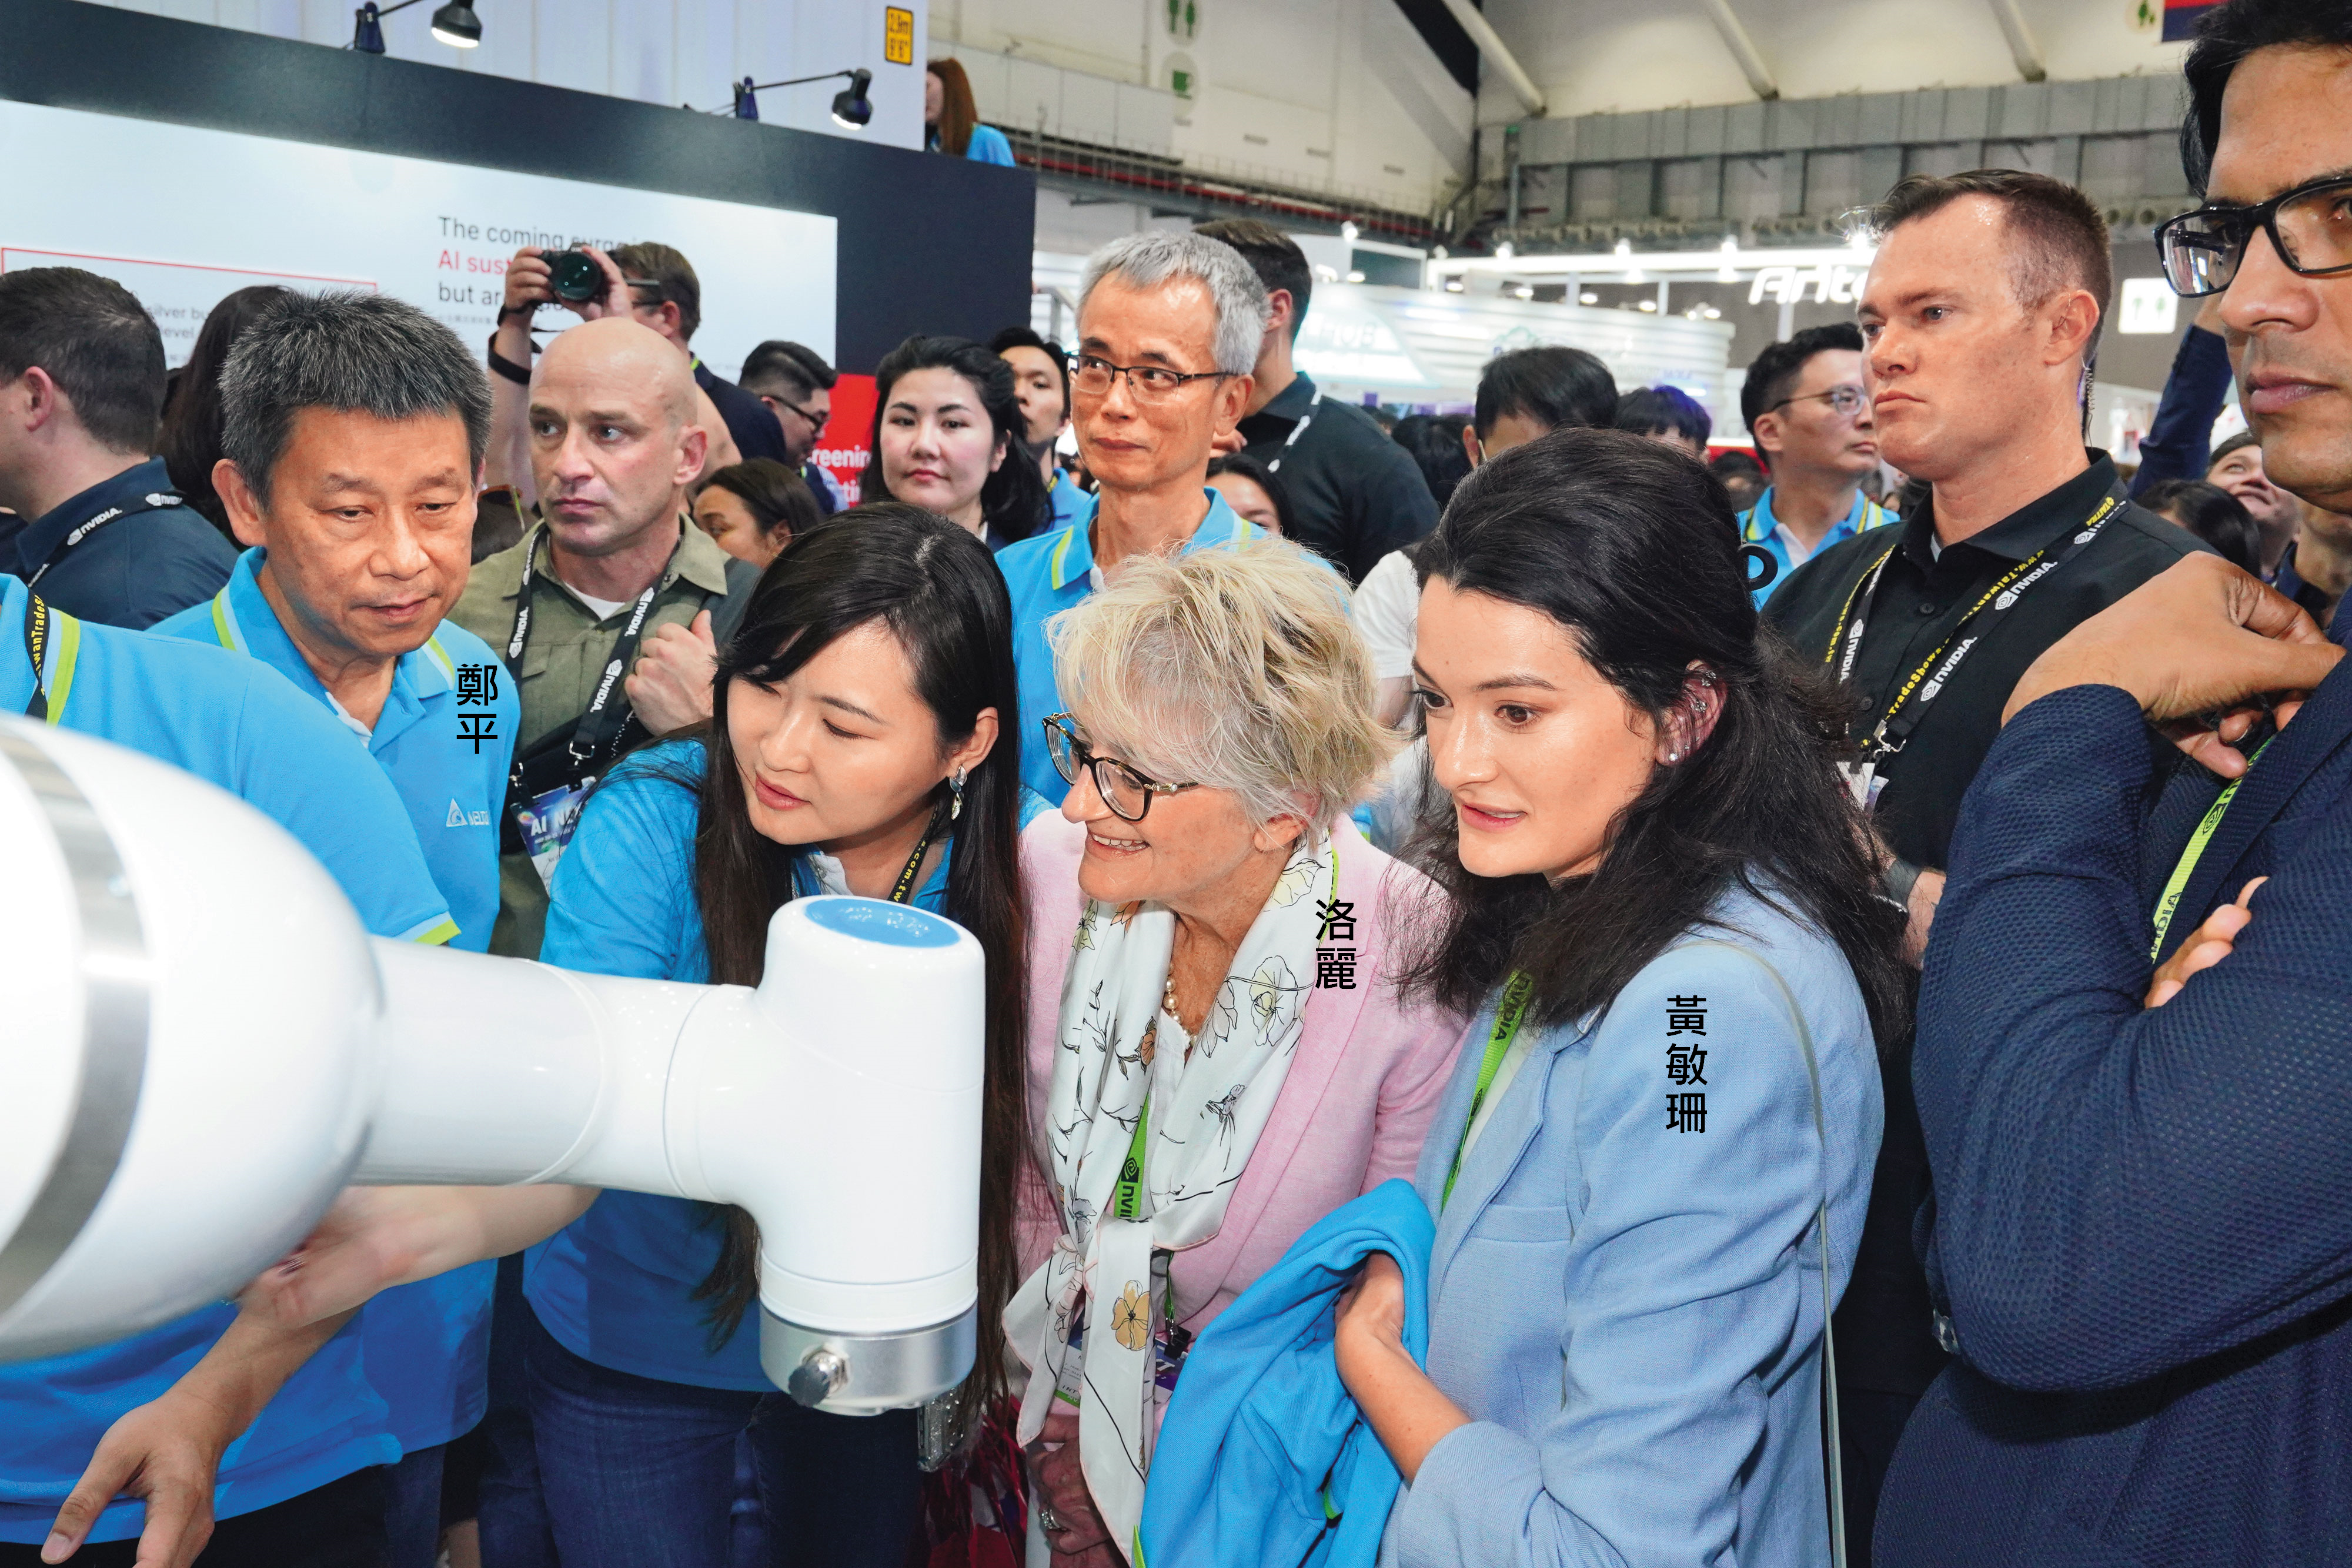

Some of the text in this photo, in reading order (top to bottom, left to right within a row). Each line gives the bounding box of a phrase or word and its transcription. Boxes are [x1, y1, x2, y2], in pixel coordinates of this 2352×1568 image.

[439, 216, 479, 240] The
[487, 226, 564, 250] coming
[439, 250, 460, 270] AI
[439, 282, 473, 304] but
[806, 444, 871, 468] reenin
[531, 815, 547, 836] AI
